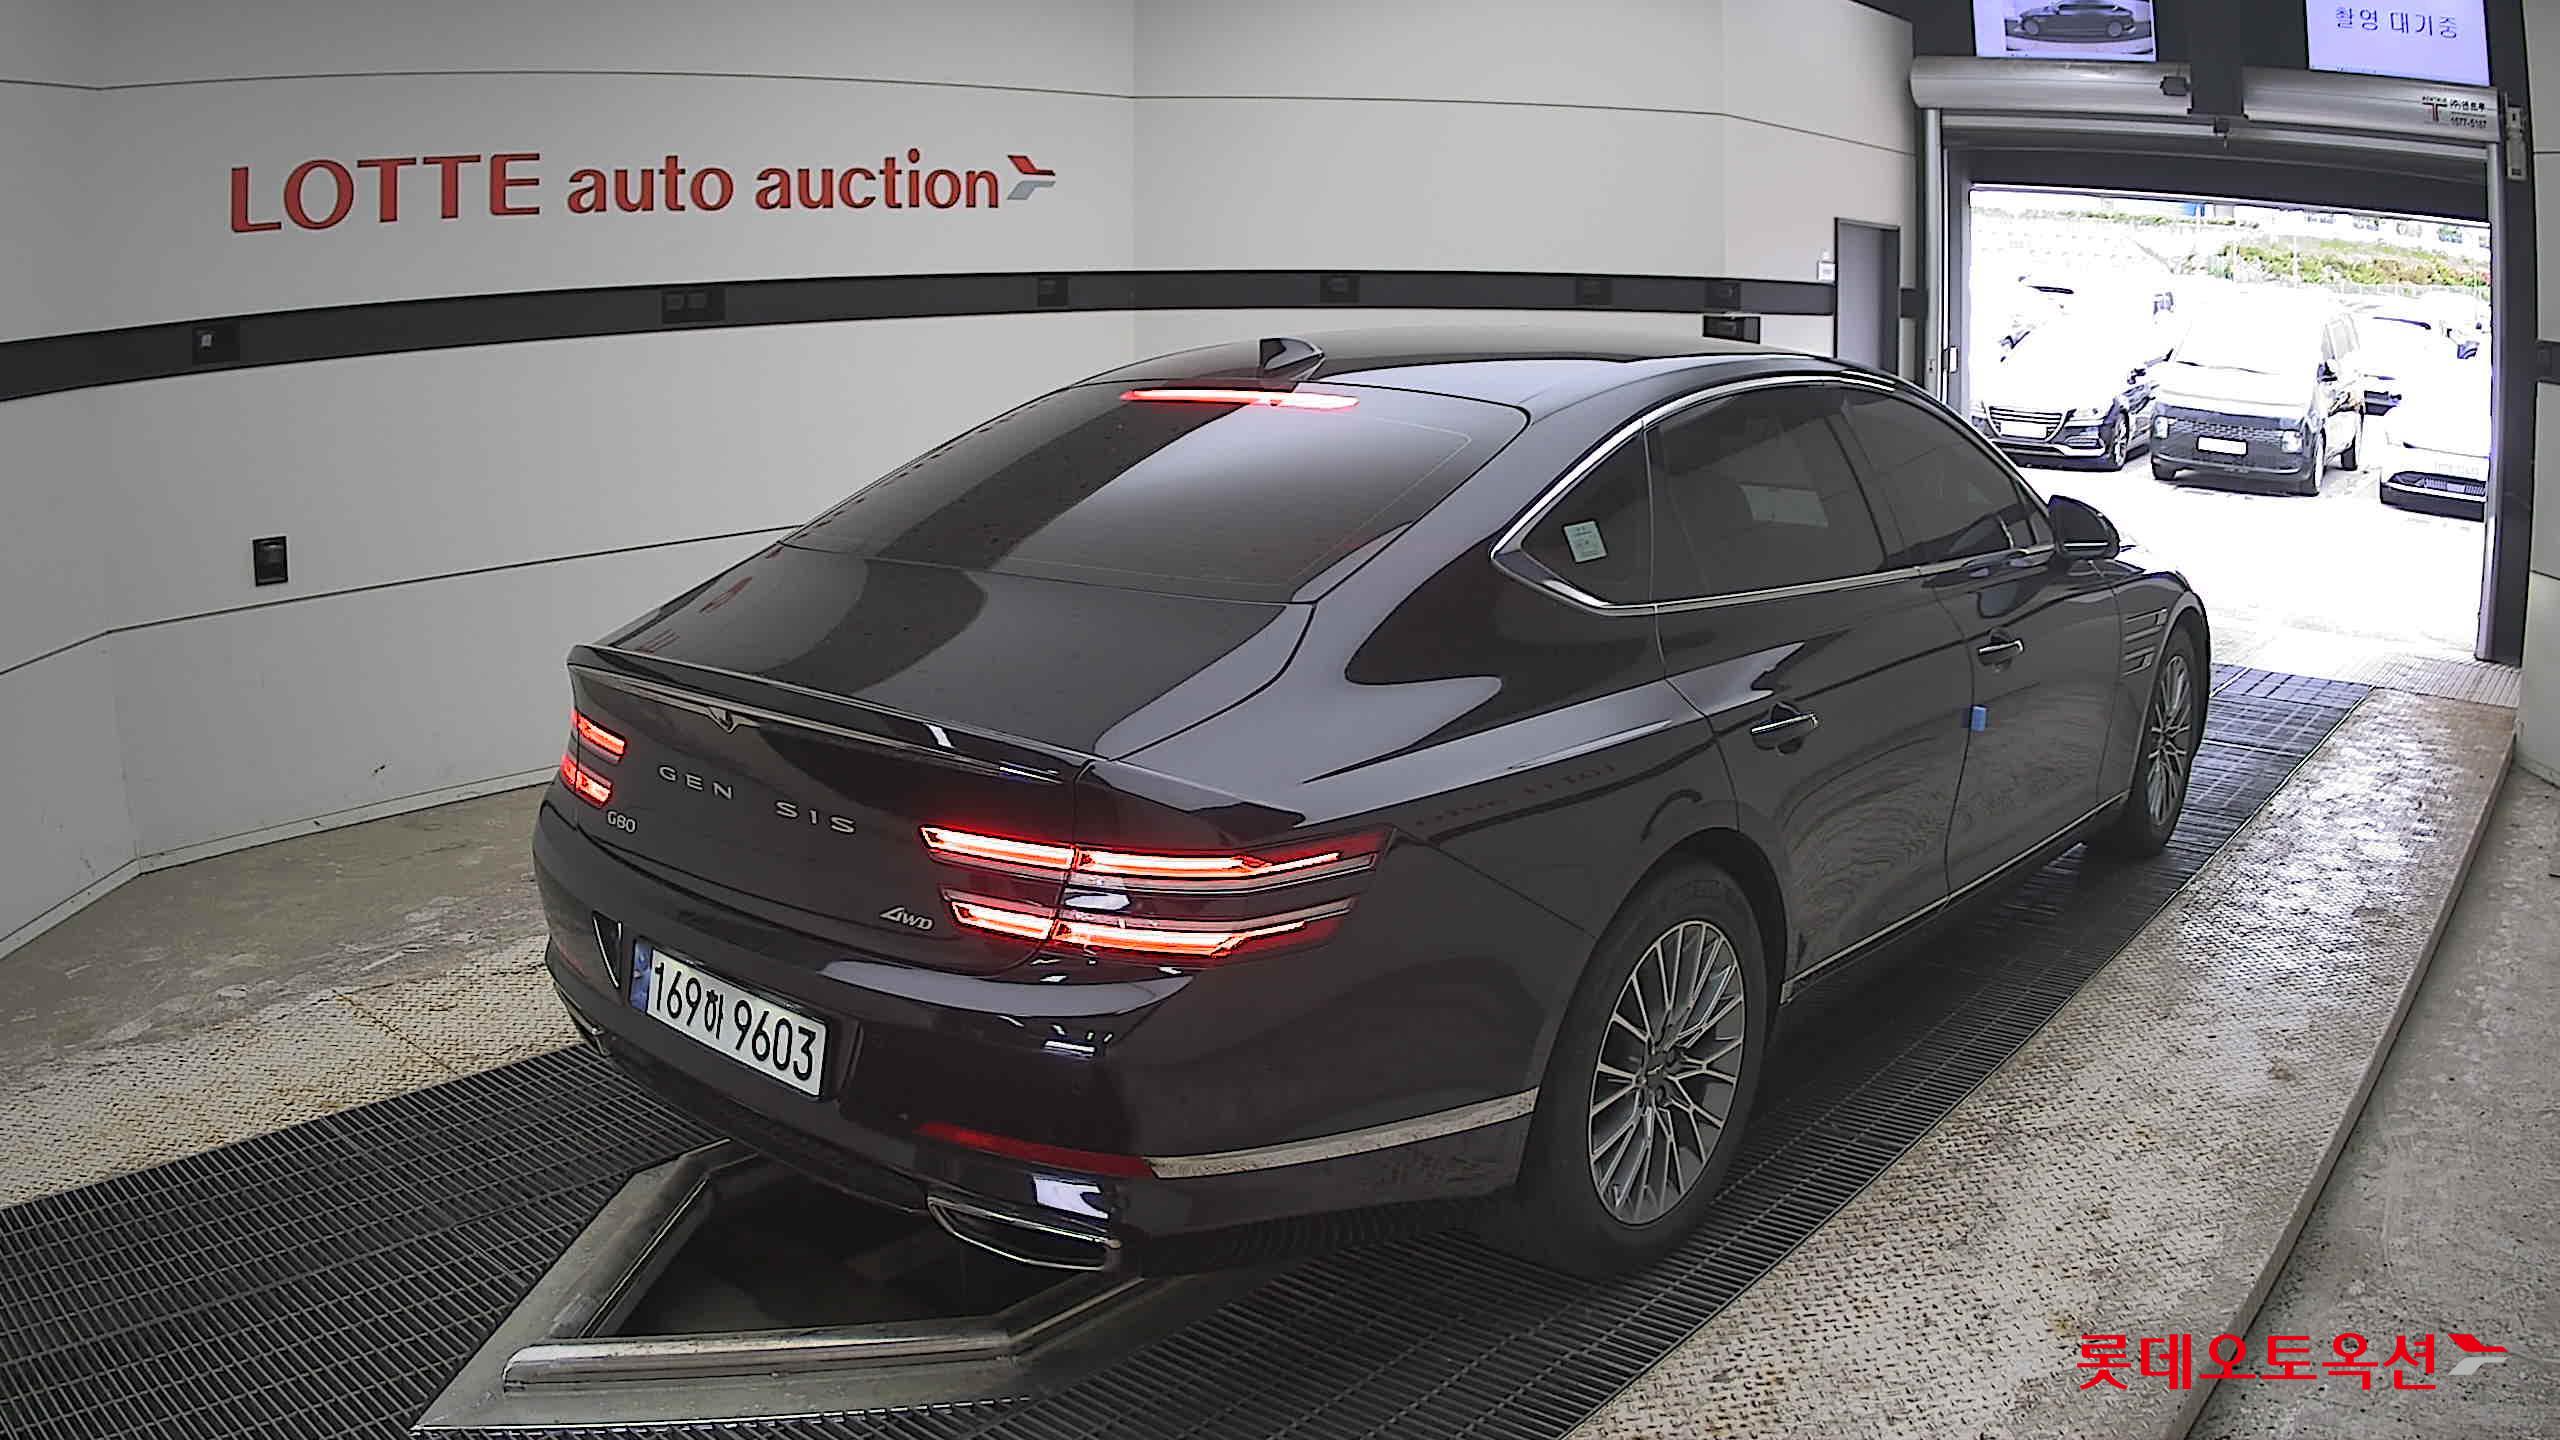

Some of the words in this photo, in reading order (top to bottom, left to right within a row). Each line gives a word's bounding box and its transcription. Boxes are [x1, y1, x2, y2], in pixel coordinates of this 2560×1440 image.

[2336, 6, 2378, 31] 촬영
[2391, 11, 2457, 39] 대기중
[231, 152, 541, 232] LOTTE
[567, 154, 734, 214] auto
[755, 147, 999, 211] auction
[607, 810, 636, 834] G80
[655, 962, 724, 1040] 169하
[734, 1000, 817, 1081] 9603
